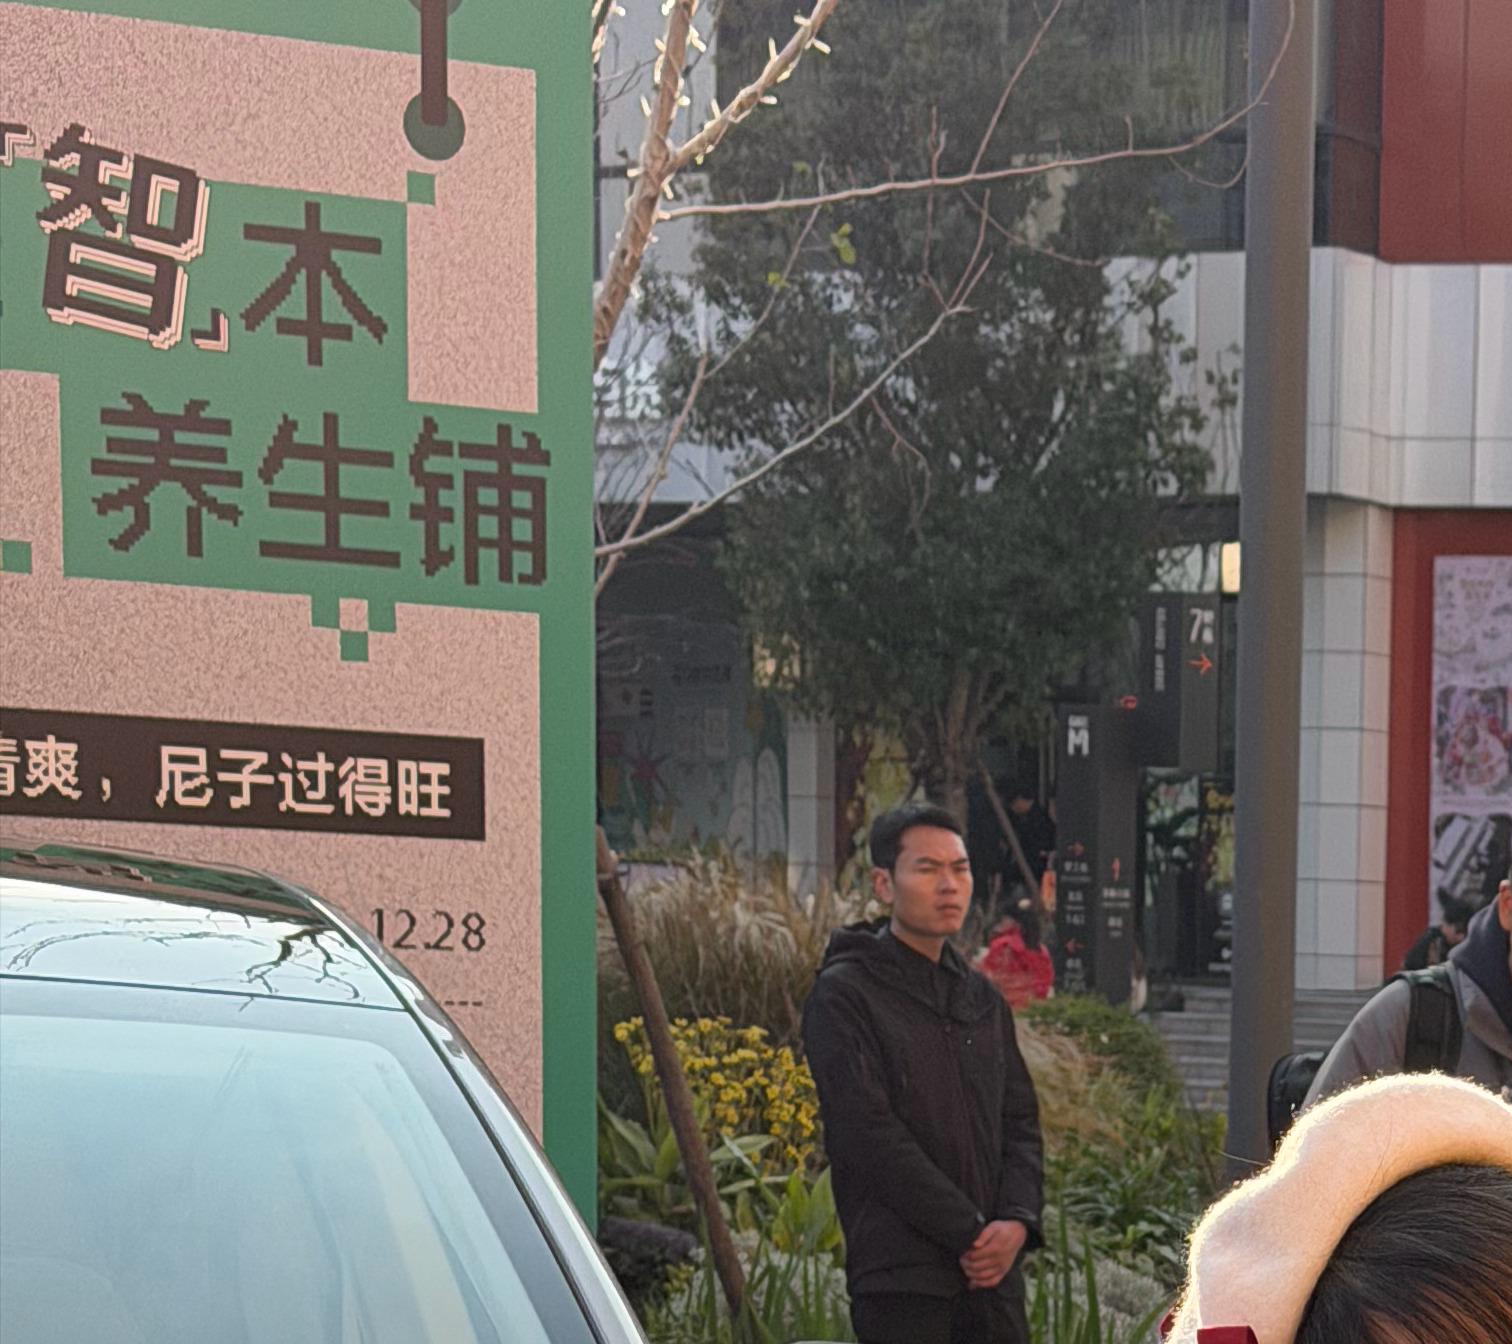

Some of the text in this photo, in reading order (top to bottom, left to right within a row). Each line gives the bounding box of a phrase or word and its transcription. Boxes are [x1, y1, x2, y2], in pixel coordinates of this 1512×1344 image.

[91, 391, 551, 586] 养生铺
[370, 908, 486, 952] 12.28
